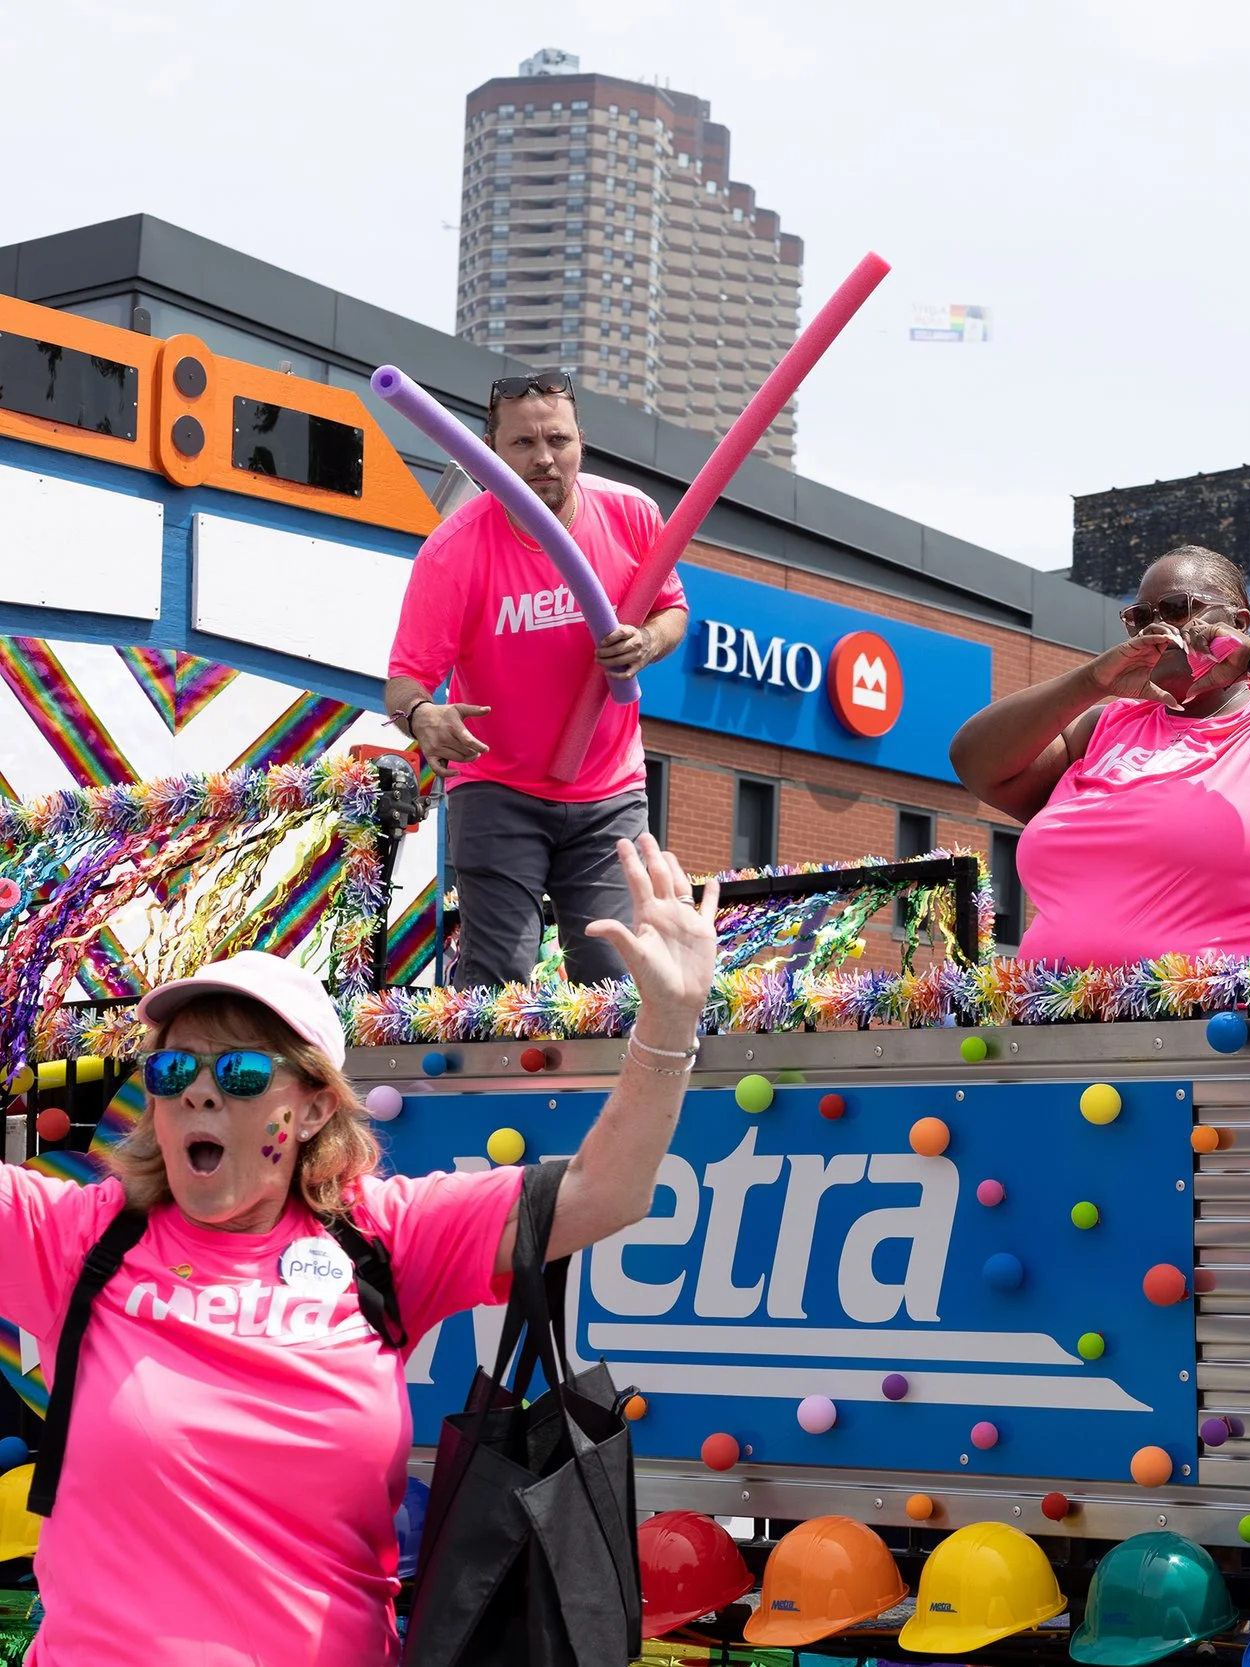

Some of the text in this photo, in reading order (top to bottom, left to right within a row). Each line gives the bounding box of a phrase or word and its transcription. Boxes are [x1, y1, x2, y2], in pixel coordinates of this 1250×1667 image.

[495, 584, 576, 635] Metr
[704, 619, 822, 693] BMO
[290, 1260, 344, 1279] pride
[771, 1600, 796, 1612] Metra
[929, 1602, 952, 1612] Metra
